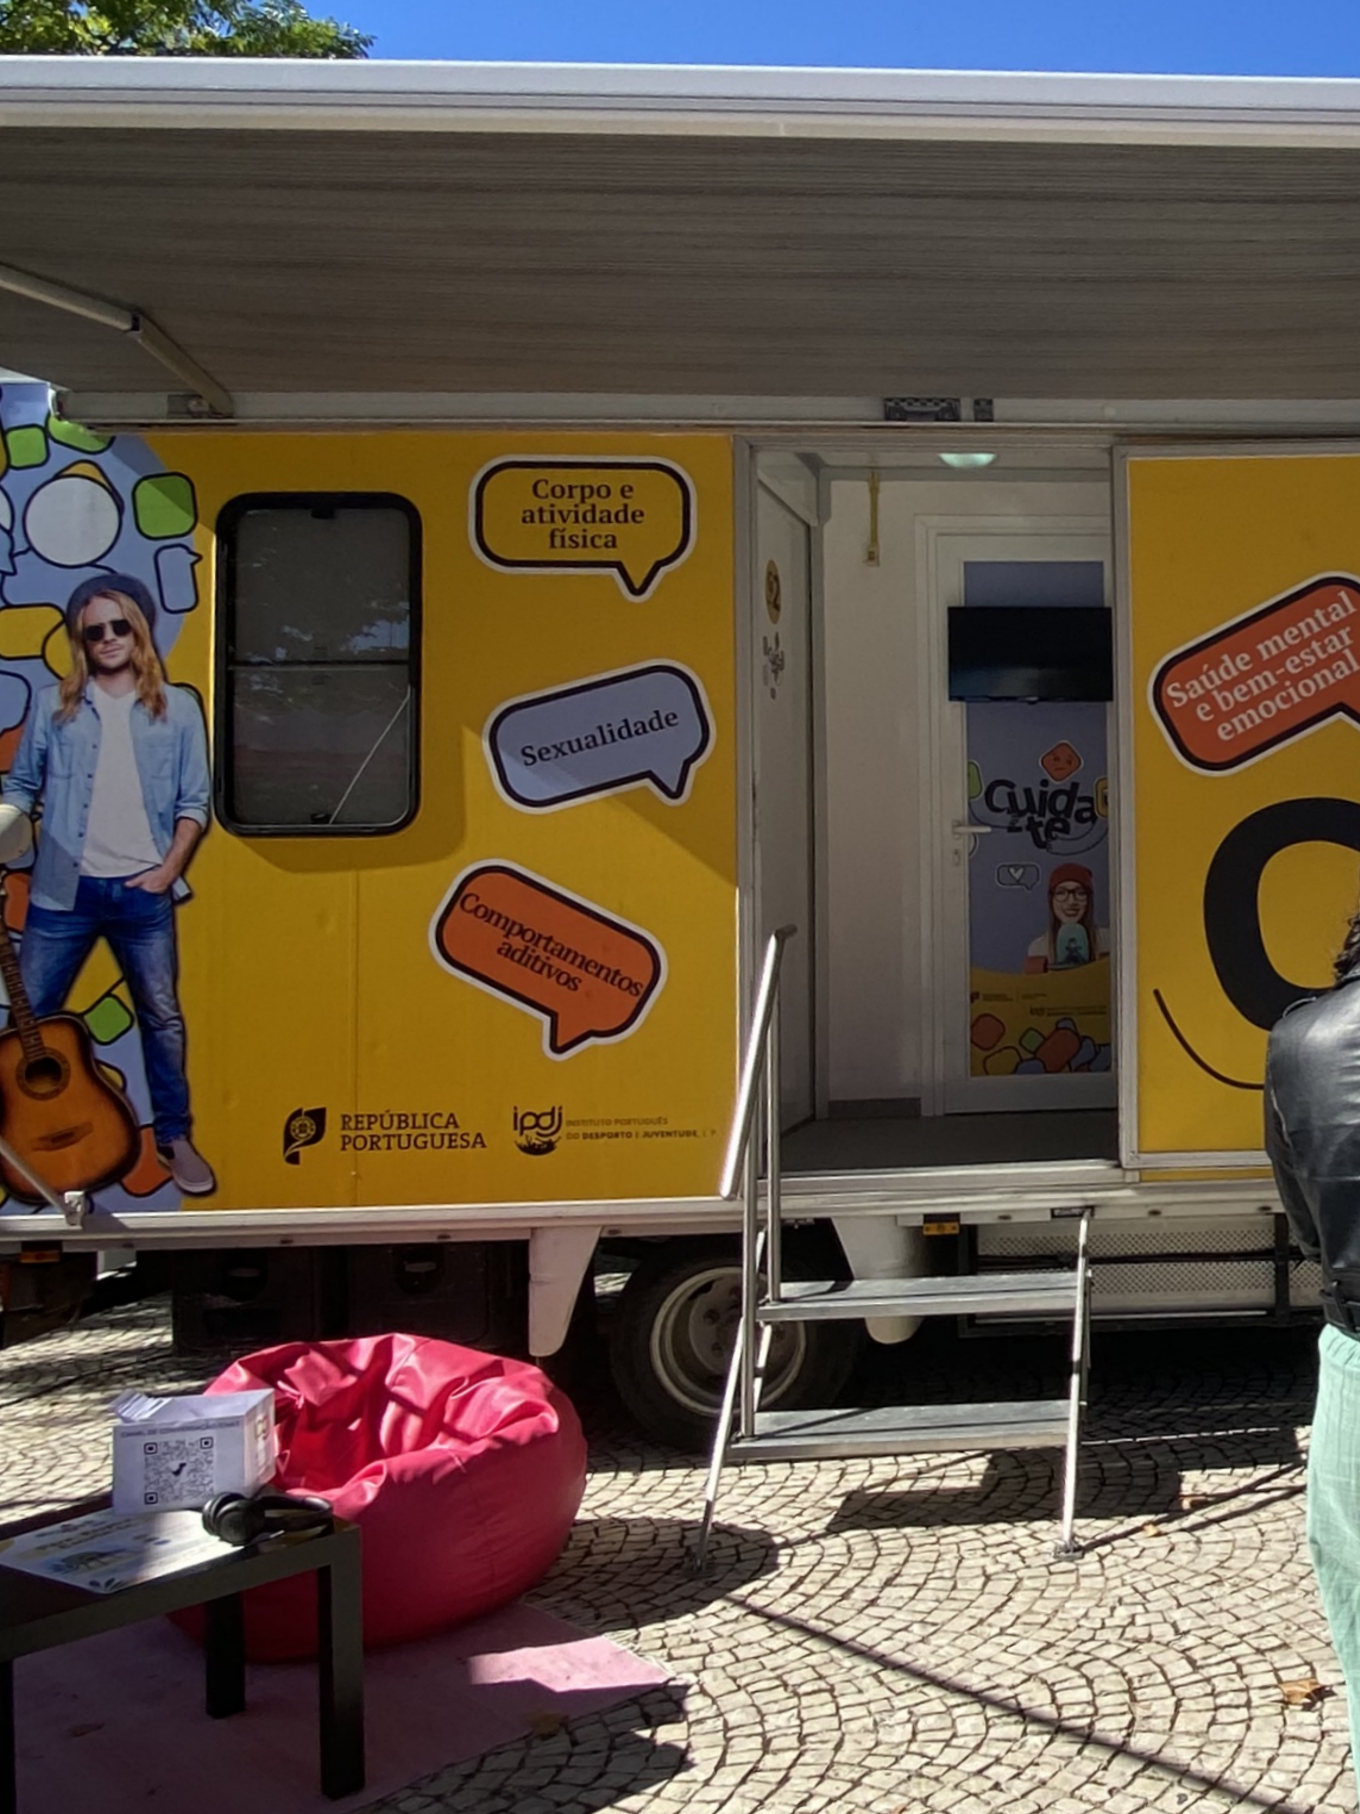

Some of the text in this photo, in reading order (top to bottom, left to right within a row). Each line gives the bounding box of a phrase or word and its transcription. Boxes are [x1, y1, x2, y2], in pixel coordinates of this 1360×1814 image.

[532, 478, 634, 503] Corpo e
[521, 503, 645, 525] atividade
[548, 528, 618, 549] física
[1166, 590, 1357, 708] Saúde mental
[1196, 626, 1354, 722] e bem-estar
[520, 709, 679, 767] Sexualidade
[984, 778, 1098, 826] Cuida
[459, 892, 645, 998] Comportamentos
[496, 941, 583, 992] aditivos
[340, 1109, 460, 1132] REPÚBLICA
[513, 1106, 563, 1138] ipdj
[565, 1116, 669, 1127] INSTITUTO PORTUGUÊS
[340, 1130, 487, 1152] PORTUGUESA
[582, 1131, 633, 1140] DESPORTO
